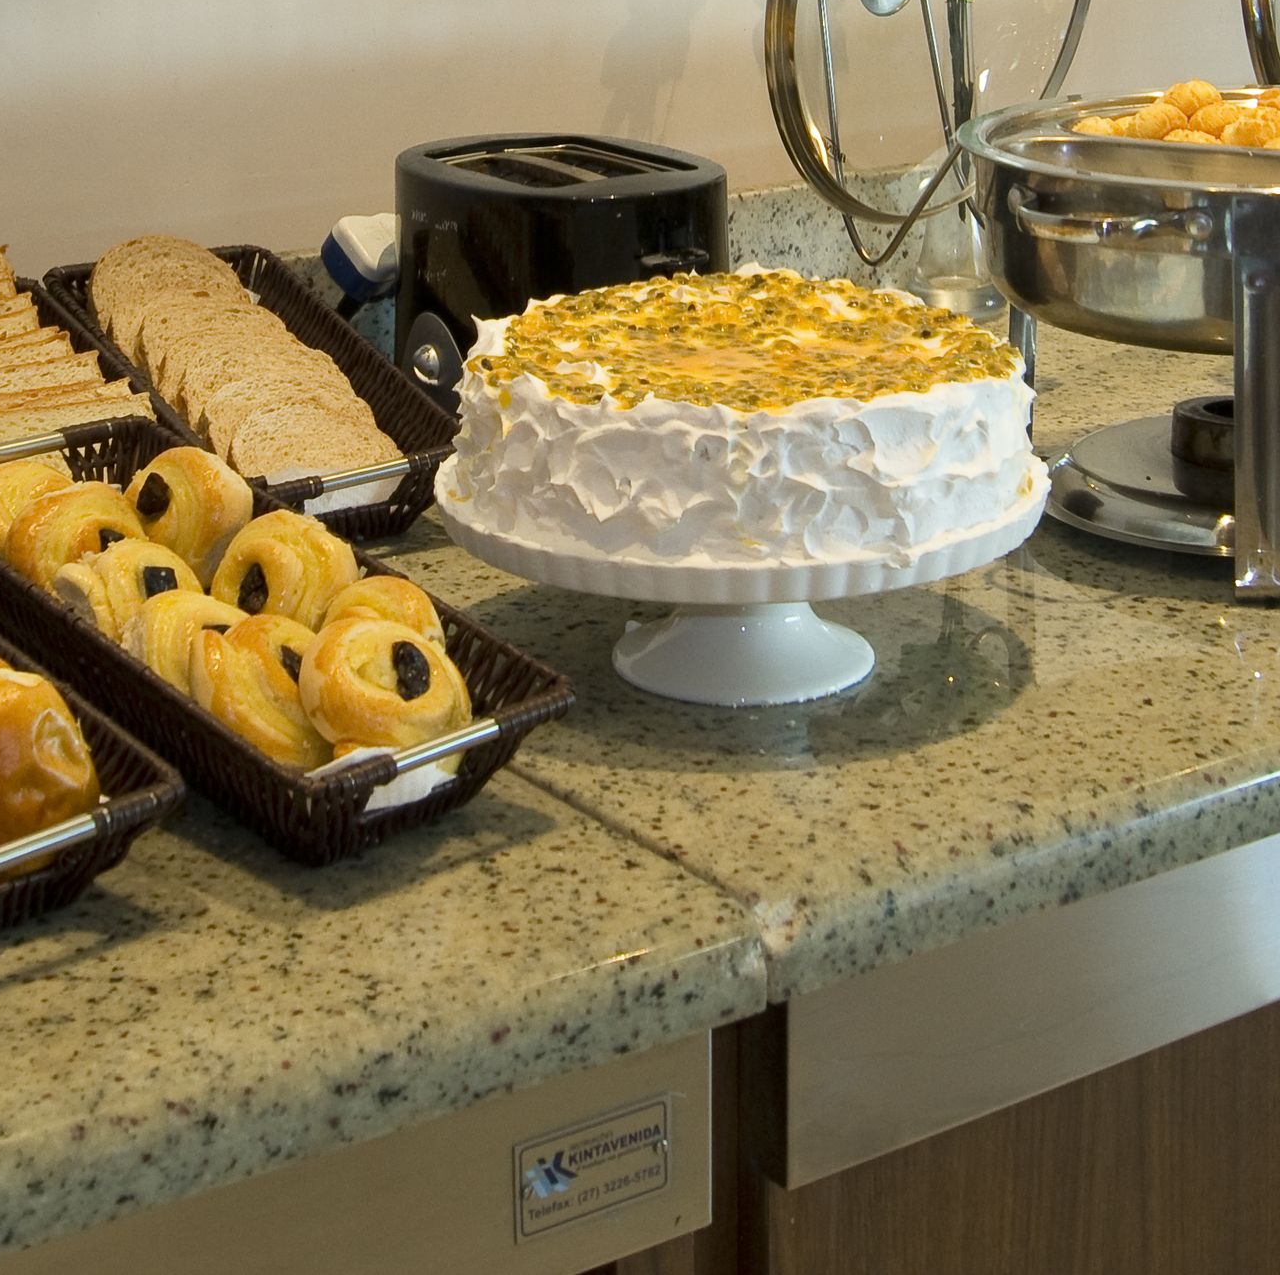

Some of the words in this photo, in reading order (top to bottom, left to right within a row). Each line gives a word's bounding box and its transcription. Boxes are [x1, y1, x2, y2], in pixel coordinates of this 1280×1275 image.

[568, 1125, 661, 1166] KINTAVENIDA
[528, 1198, 574, 1221] Telefax:
[577, 1187, 600, 1206] (27)
